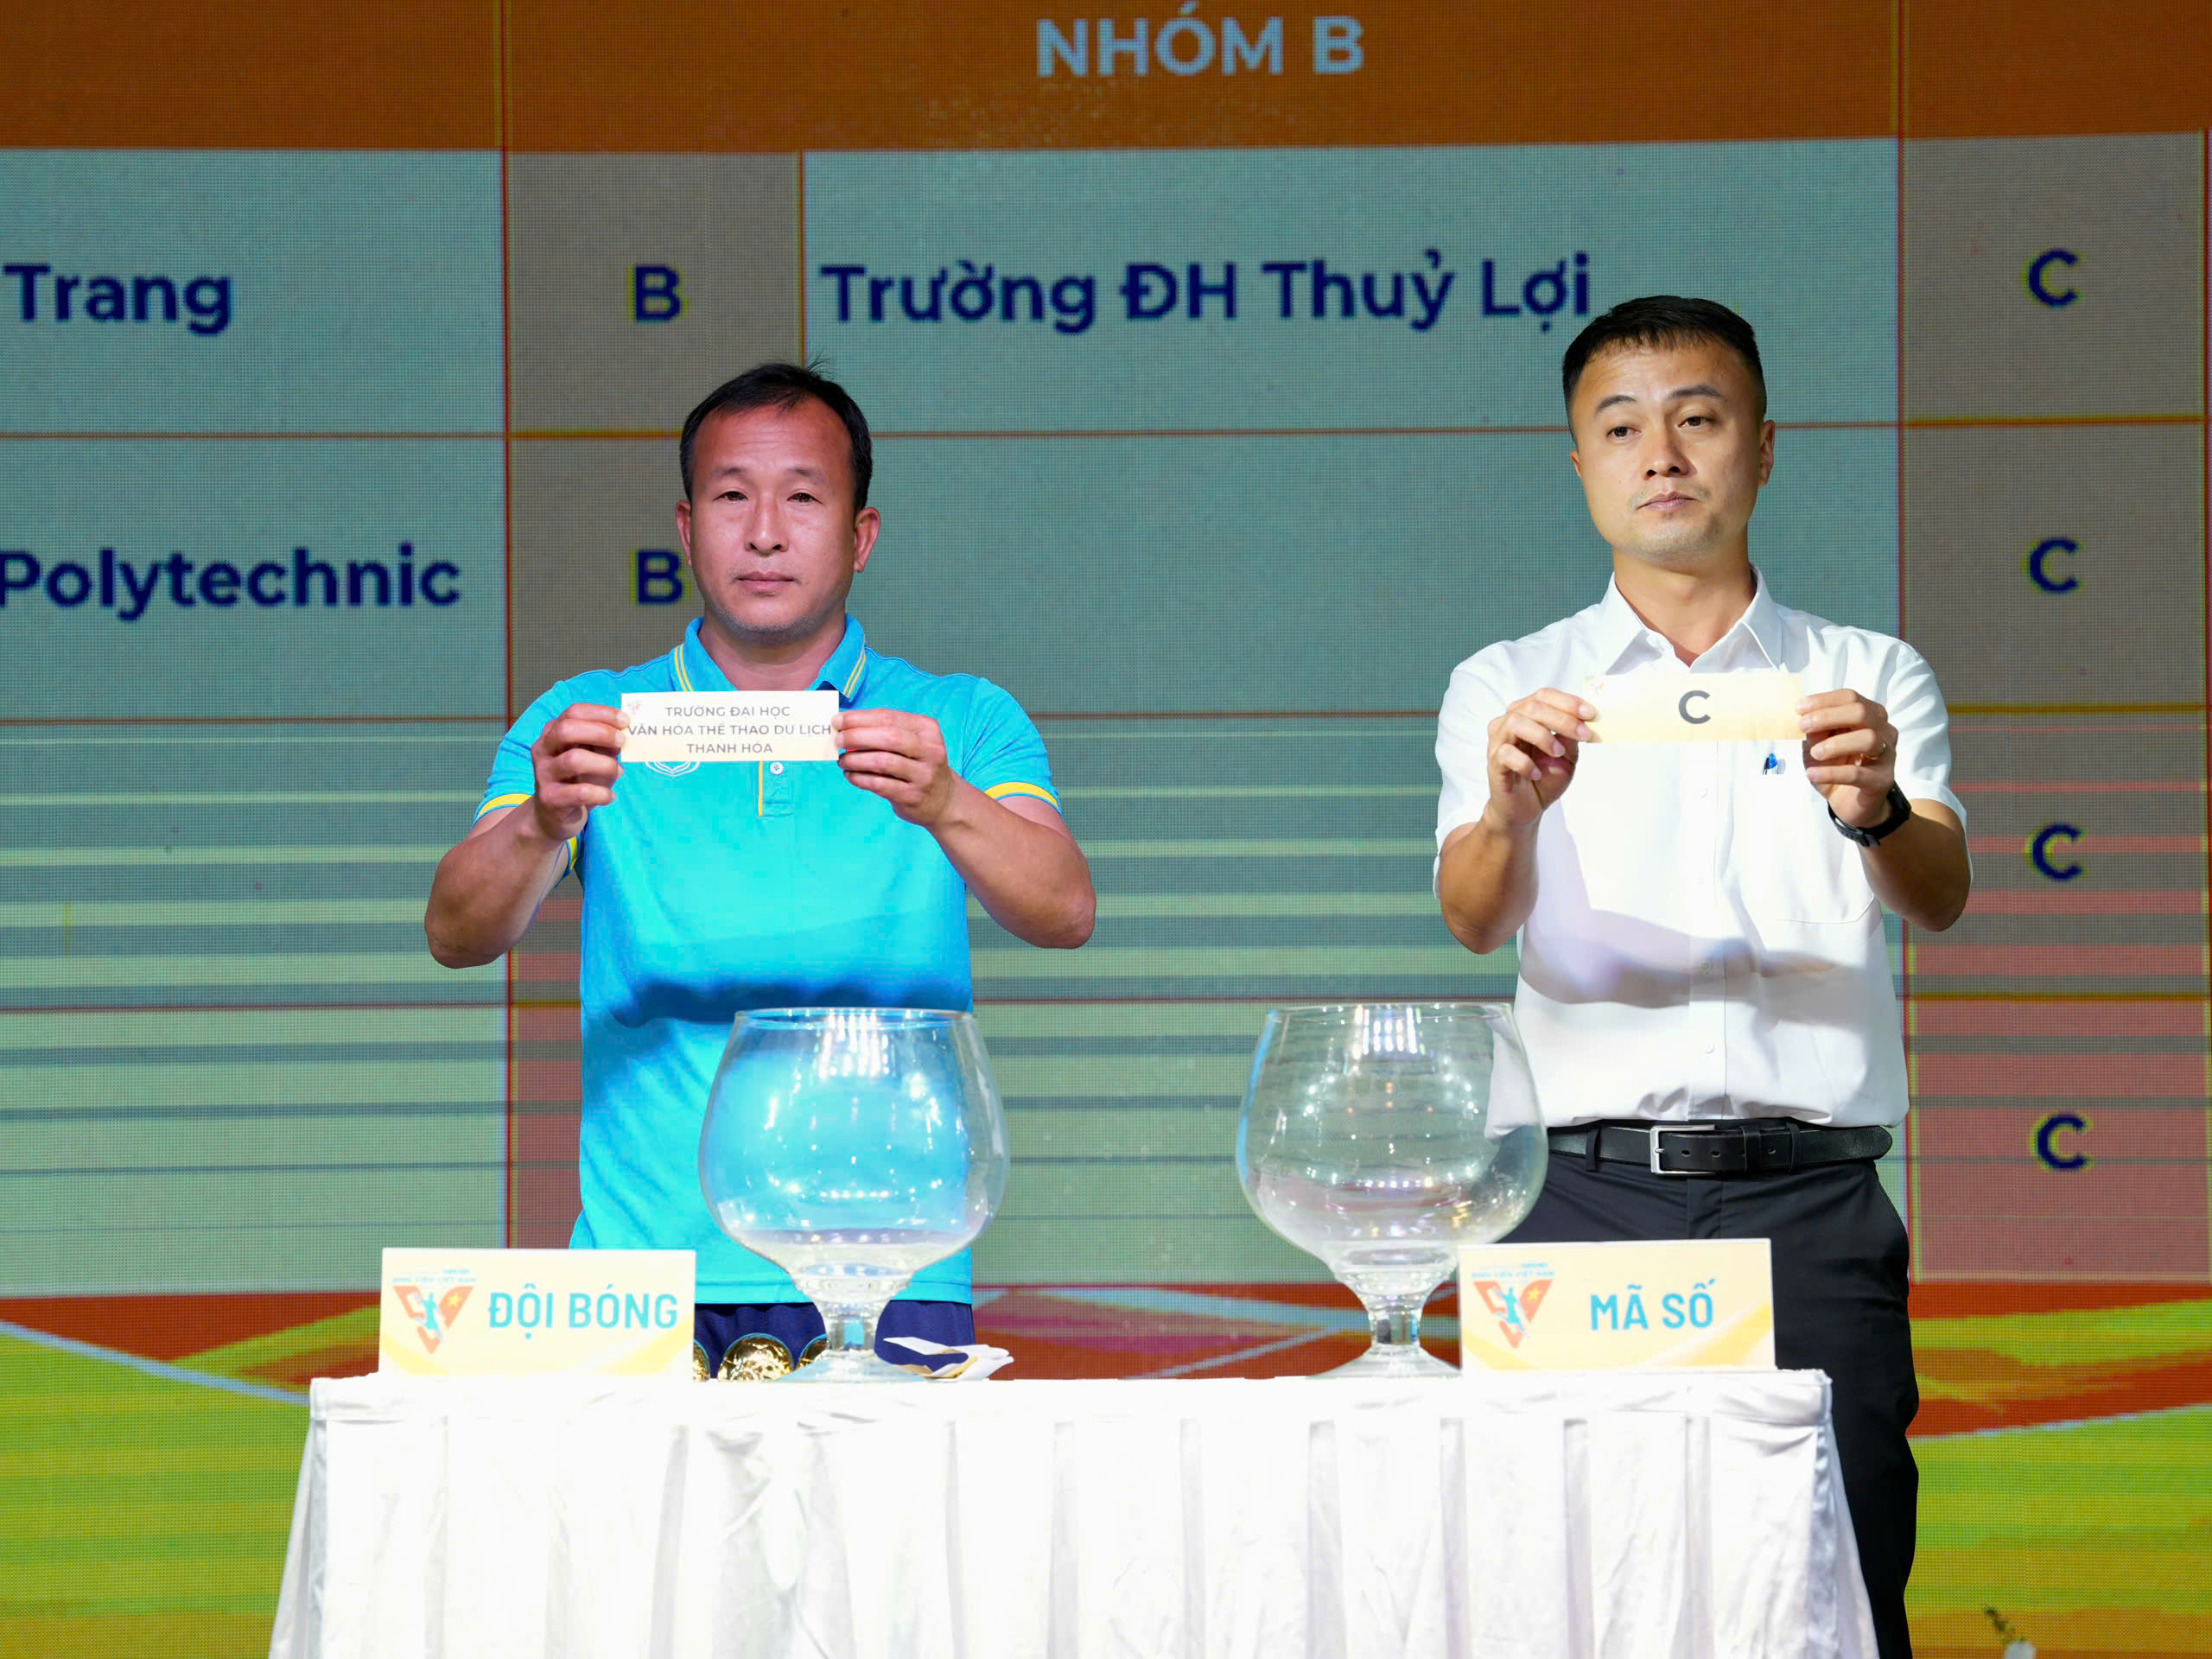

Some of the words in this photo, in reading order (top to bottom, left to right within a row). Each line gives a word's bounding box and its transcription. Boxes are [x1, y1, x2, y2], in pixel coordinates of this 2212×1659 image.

[1037, 1, 1284, 78] NHÓM
[1313, 15, 1364, 75] B
[3, 264, 232, 336] Trang
[632, 264, 683, 322] B
[820, 260, 1096, 334] Trường
[1120, 262, 1236, 319] ĐH
[1262, 249, 1454, 332] Thuỷ
[1481, 251, 1590, 333] Lợi
[2027, 248, 2079, 308] C
[0, 543, 461, 622] Polytechnic
[637, 549, 683, 605] B
[2028, 537, 2080, 594] C
[628, 723, 658, 735] VĂN
[662, 722, 693, 735] HÓA
[729, 725, 770, 734] THAO
[774, 725, 795, 734] DU
[665, 705, 726, 717] TRƯỜNG
[760, 707, 791, 720] HỌC
[1678, 690, 1711, 725] C
[687, 743, 737, 753] THANH
[741, 741, 773, 753] HÓA
[2031, 824, 2083, 881] C
[2036, 1114, 2088, 1171] C
[488, 1283, 554, 1340] ĐỘI
[569, 1283, 677, 1329] BÓNG
[1590, 1283, 1649, 1331] MÃ
[1662, 1278, 1715, 1329] SỐ
